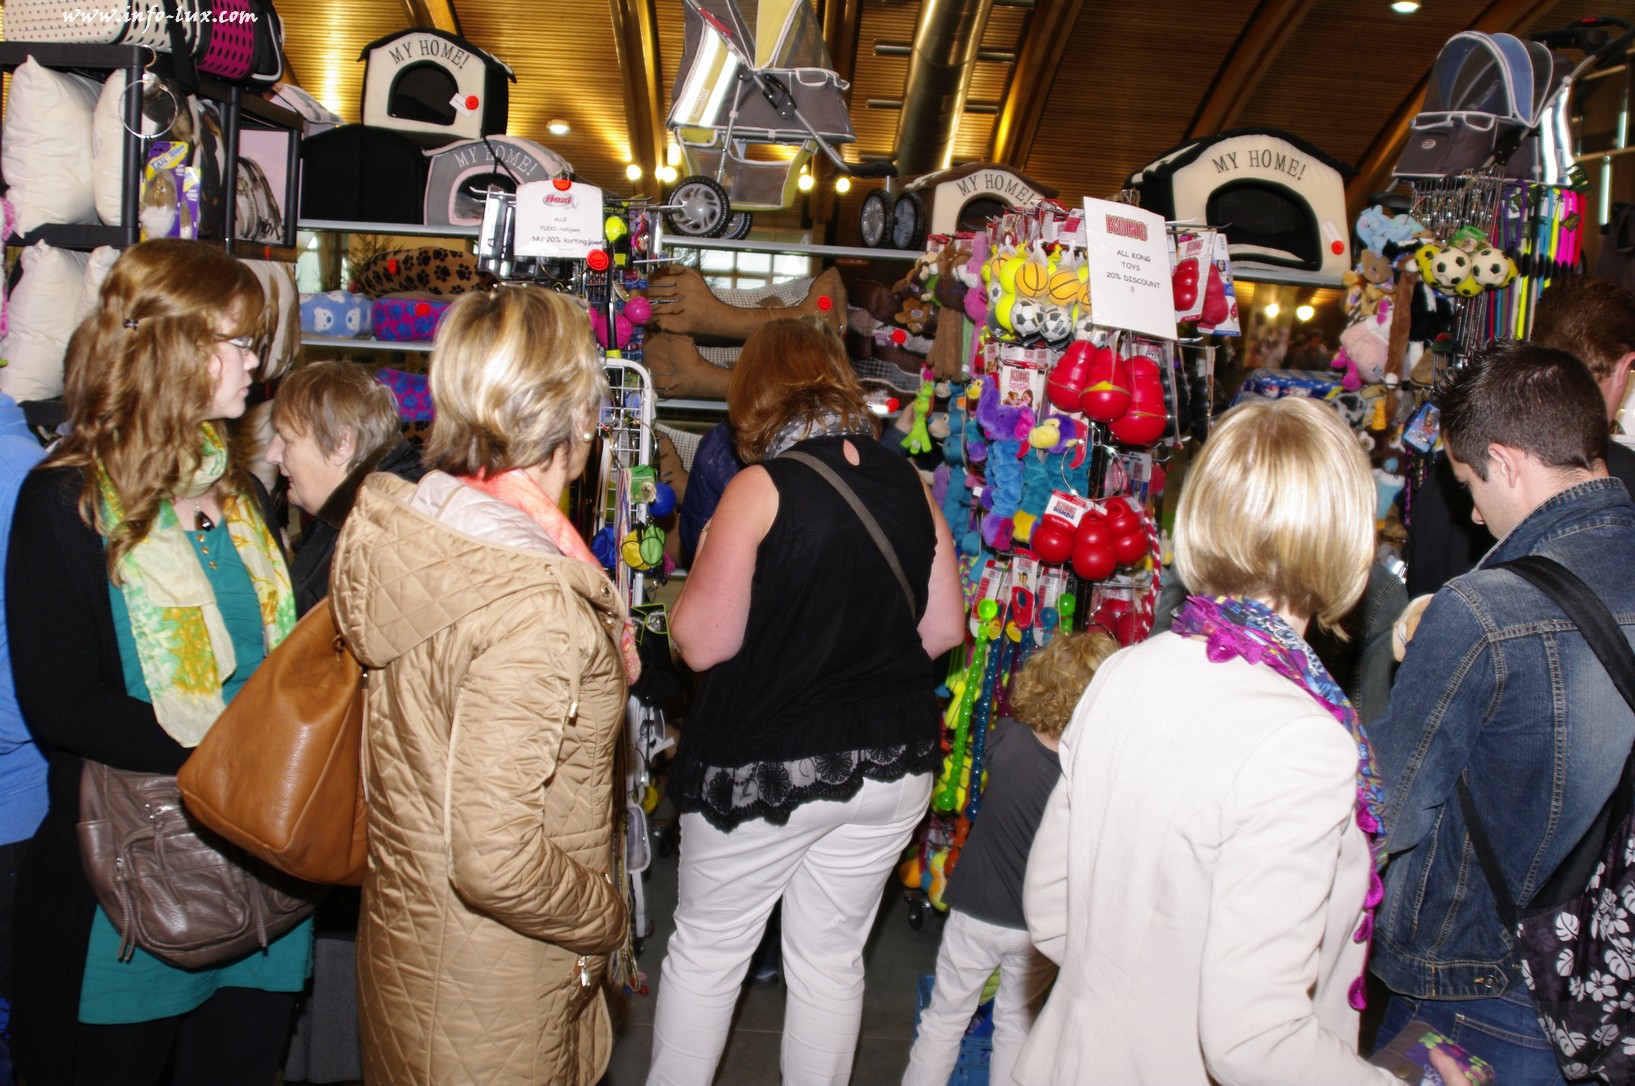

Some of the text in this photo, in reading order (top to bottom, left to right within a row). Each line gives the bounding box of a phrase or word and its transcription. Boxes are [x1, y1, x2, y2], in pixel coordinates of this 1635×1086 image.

[388, 39, 470, 69] MY HOME!
[453, 146, 477, 168] MY
[1211, 149, 1306, 180] MY HOME!
[956, 173, 1035, 206] MY HOME!
[1105, 213, 1149, 242] KONG
[546, 236, 561, 244] 20%
[1116, 249, 1152, 263] ALL KONG
[1121, 261, 1142, 272] TOYS
[1106, 271, 1161, 289] 20% DISCOUNT
